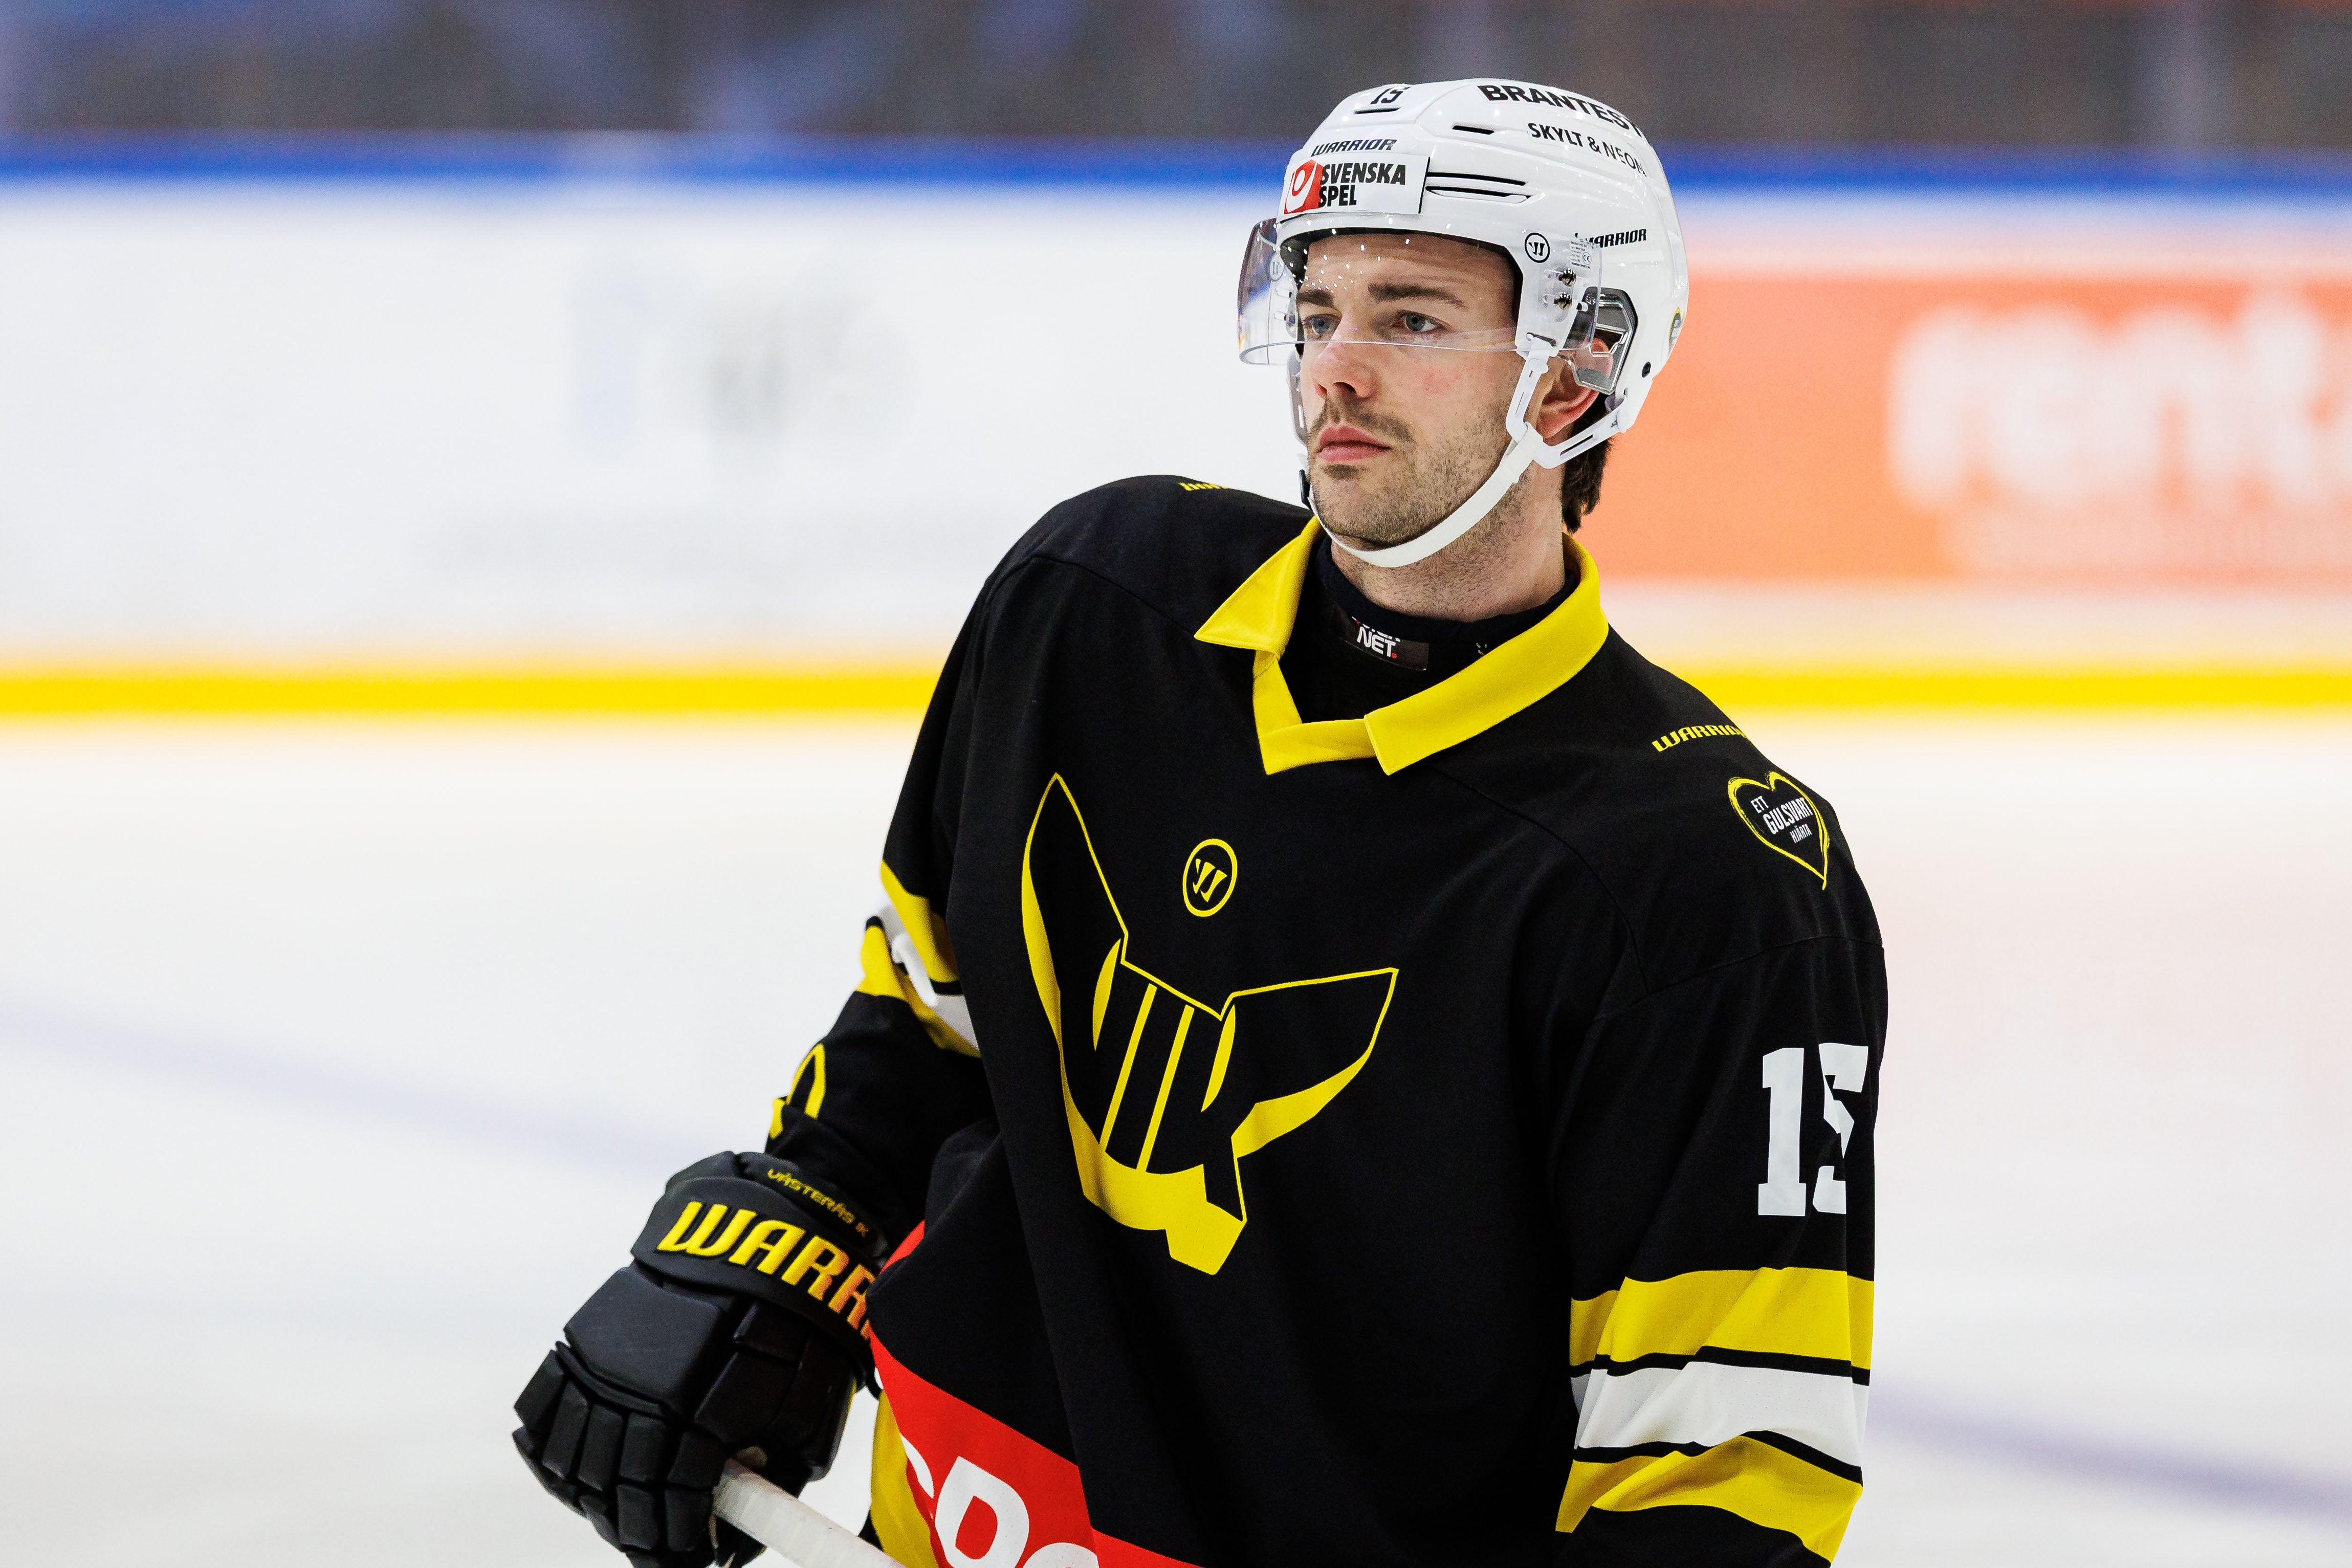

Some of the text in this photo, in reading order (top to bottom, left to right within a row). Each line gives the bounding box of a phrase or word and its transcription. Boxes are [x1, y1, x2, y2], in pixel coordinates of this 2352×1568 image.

[1369, 86, 1411, 105] 15
[1310, 139, 1397, 157] WARRIOR
[1527, 122, 1647, 177] SKYLT & NEON
[1320, 162, 1406, 185] SVENSKA
[1317, 184, 1357, 208] SPEL
[1750, 796, 1769, 814] ETT
[1763, 797, 1813, 834] GULSVART
[1758, 1042, 1869, 1217] 15
[657, 1201, 876, 1341] WARR
